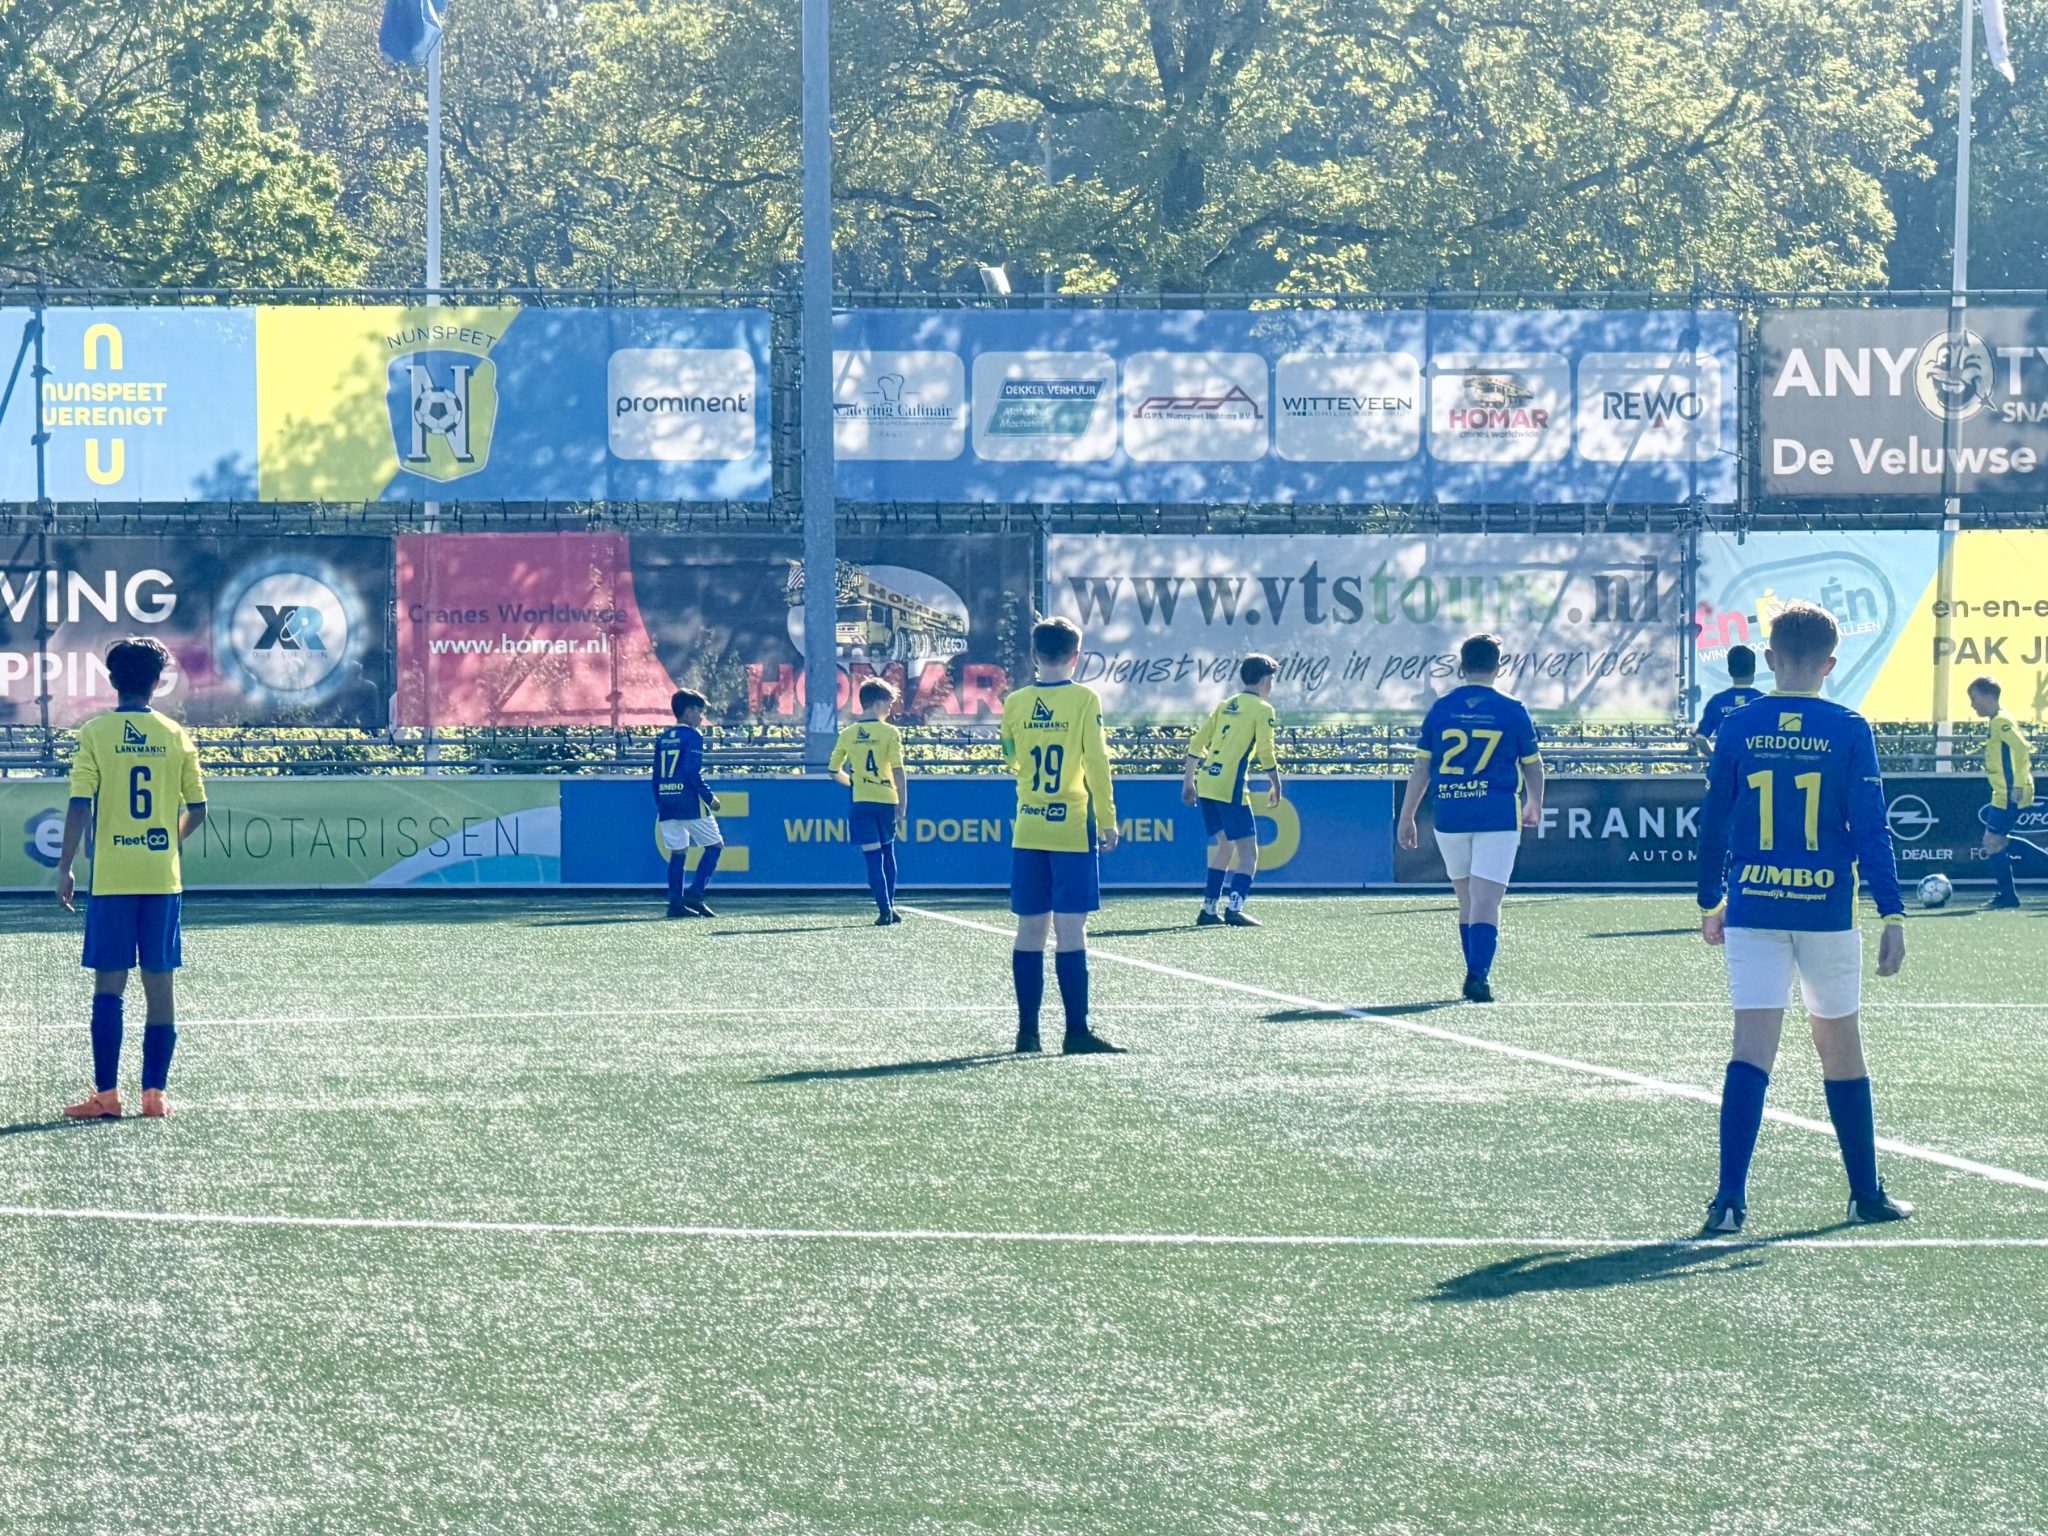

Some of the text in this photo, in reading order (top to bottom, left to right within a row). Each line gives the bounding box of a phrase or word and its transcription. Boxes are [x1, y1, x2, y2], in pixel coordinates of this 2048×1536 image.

[386, 325, 497, 349] NUNSPEET
[1772, 346, 2048, 397] ANY T
[41, 382, 168, 401] NUNSPEET
[1005, 385, 1096, 396] DEKKER VERHUUR
[1282, 396, 1413, 411] WITTEVEEN
[616, 393, 747, 418] prominent
[897, 403, 953, 417] Culinair
[1448, 408, 1549, 430] HOMAR
[1602, 391, 1704, 421] REWO
[1773, 435, 2038, 475] De Veluwse
[0, 569, 177, 624] VING
[1068, 555, 1662, 626] www.vtstours.nl
[409, 604, 489, 624] Cranes
[429, 633, 607, 655] www.homar.nl
[1933, 635, 2048, 665] PAK J
[1343, 649, 1371, 682] in
[661, 749, 680, 778] 17
[866, 750, 878, 776] 4
[1439, 728, 1503, 775] 27
[1030, 744, 1064, 794] 19
[130, 766, 152, 819] 6
[1537, 806, 1701, 839] FRANK
[1747, 769, 1822, 851] 11
[203, 808, 520, 859] NOTARISSEN
[916, 818, 998, 842] DOEN
[1902, 849, 1953, 860] DEALER
[1738, 864, 1835, 888] JUMBO
